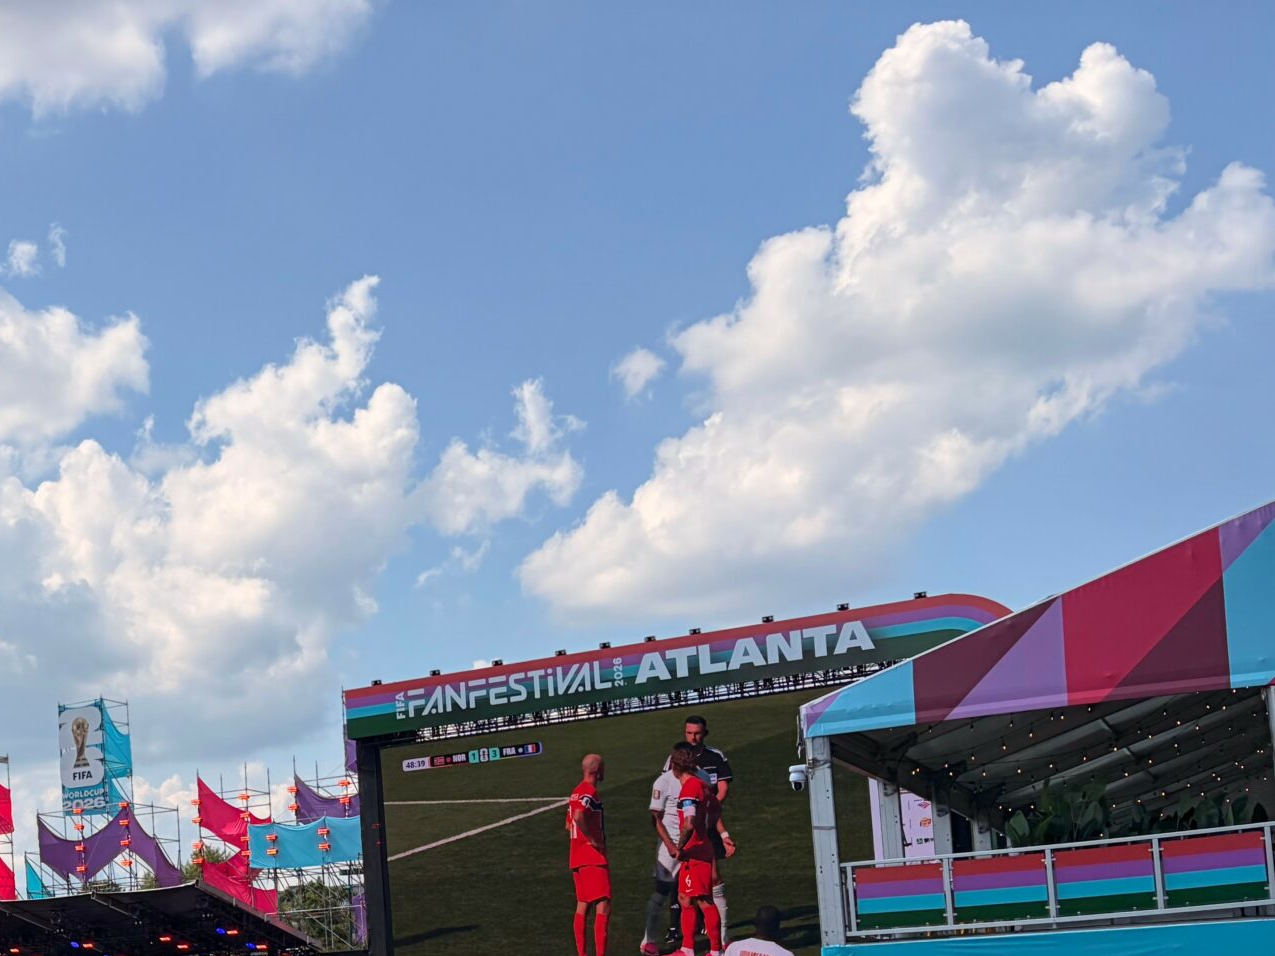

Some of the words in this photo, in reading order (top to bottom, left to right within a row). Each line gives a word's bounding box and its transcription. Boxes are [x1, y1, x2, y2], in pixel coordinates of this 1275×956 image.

[396, 691, 405, 719] FIFA
[612, 657, 623, 687] 2026
[635, 620, 875, 684] ATLANTA
[452, 754, 467, 763] NOR
[502, 747, 516, 756] FRA
[72, 770, 93, 781] FIFA
[62, 797, 106, 810] 2026
